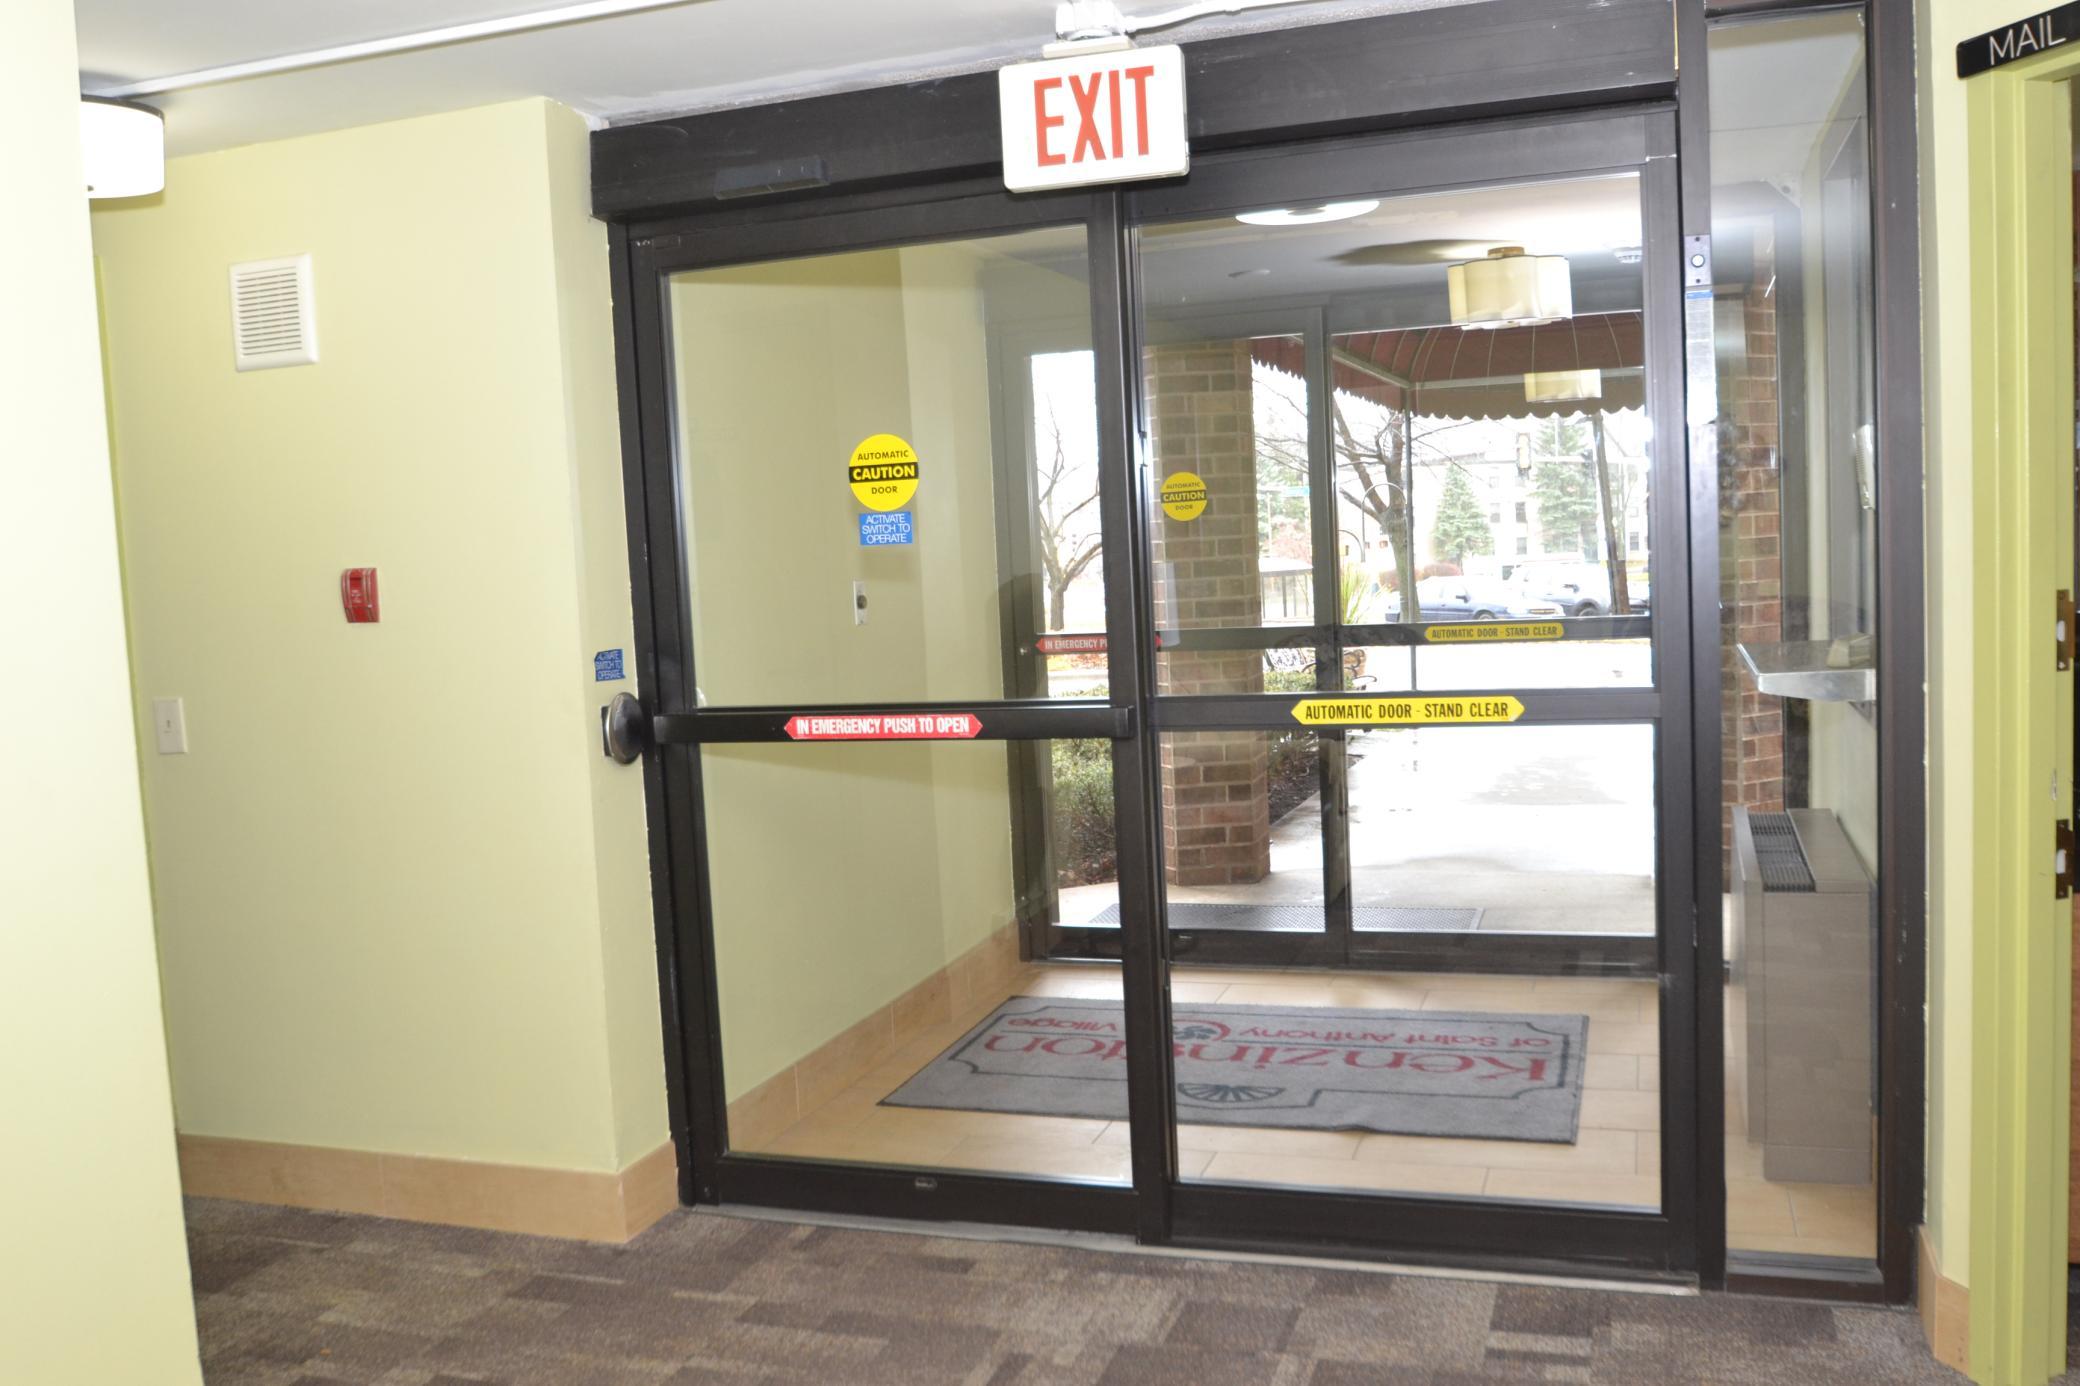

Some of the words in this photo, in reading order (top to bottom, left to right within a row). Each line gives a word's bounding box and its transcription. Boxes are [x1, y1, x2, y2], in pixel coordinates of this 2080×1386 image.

[1988, 15, 2067, 66] MAIL
[1033, 65, 1154, 168] EXIT
[857, 450, 909, 461] AUTOMATIC
[853, 465, 915, 480] CAUTION
[871, 486, 898, 495] DOOR
[1163, 491, 1205, 501] CAUTION
[866, 513, 905, 525] ACTIVATE
[862, 524, 896, 535] SWITCH
[898, 523, 911, 534] TO
[866, 534, 907, 544] OPERATE
[1432, 628, 1474, 639] AUTOMATIC
[1477, 627, 1499, 637] DOOR
[1505, 626, 1530, 637] STAND
[1533, 626, 1558, 636] CLEAR
[1045, 640, 1054, 650] IN
[1055, 638, 1098, 650] EMERGENCY
[1305, 704, 1374, 720] AUTOMATIC
[1379, 703, 1411, 719] DOOR
[1425, 703, 1463, 718] STAND
[1470, 702, 1509, 717] CLEAR
[796, 719, 810, 735] IN
[811, 718, 881, 734] EMERGENCY
[884, 717, 915, 734] PUSH
[919, 717, 934, 733] TO
[937, 716, 970, 733] OPEN
[1007, 1016, 1118, 1032] Village
[1240, 1026, 1396, 1044] Anthony
[1403, 1032, 1498, 1047] Saint
[1506, 1036, 1553, 1048] of
